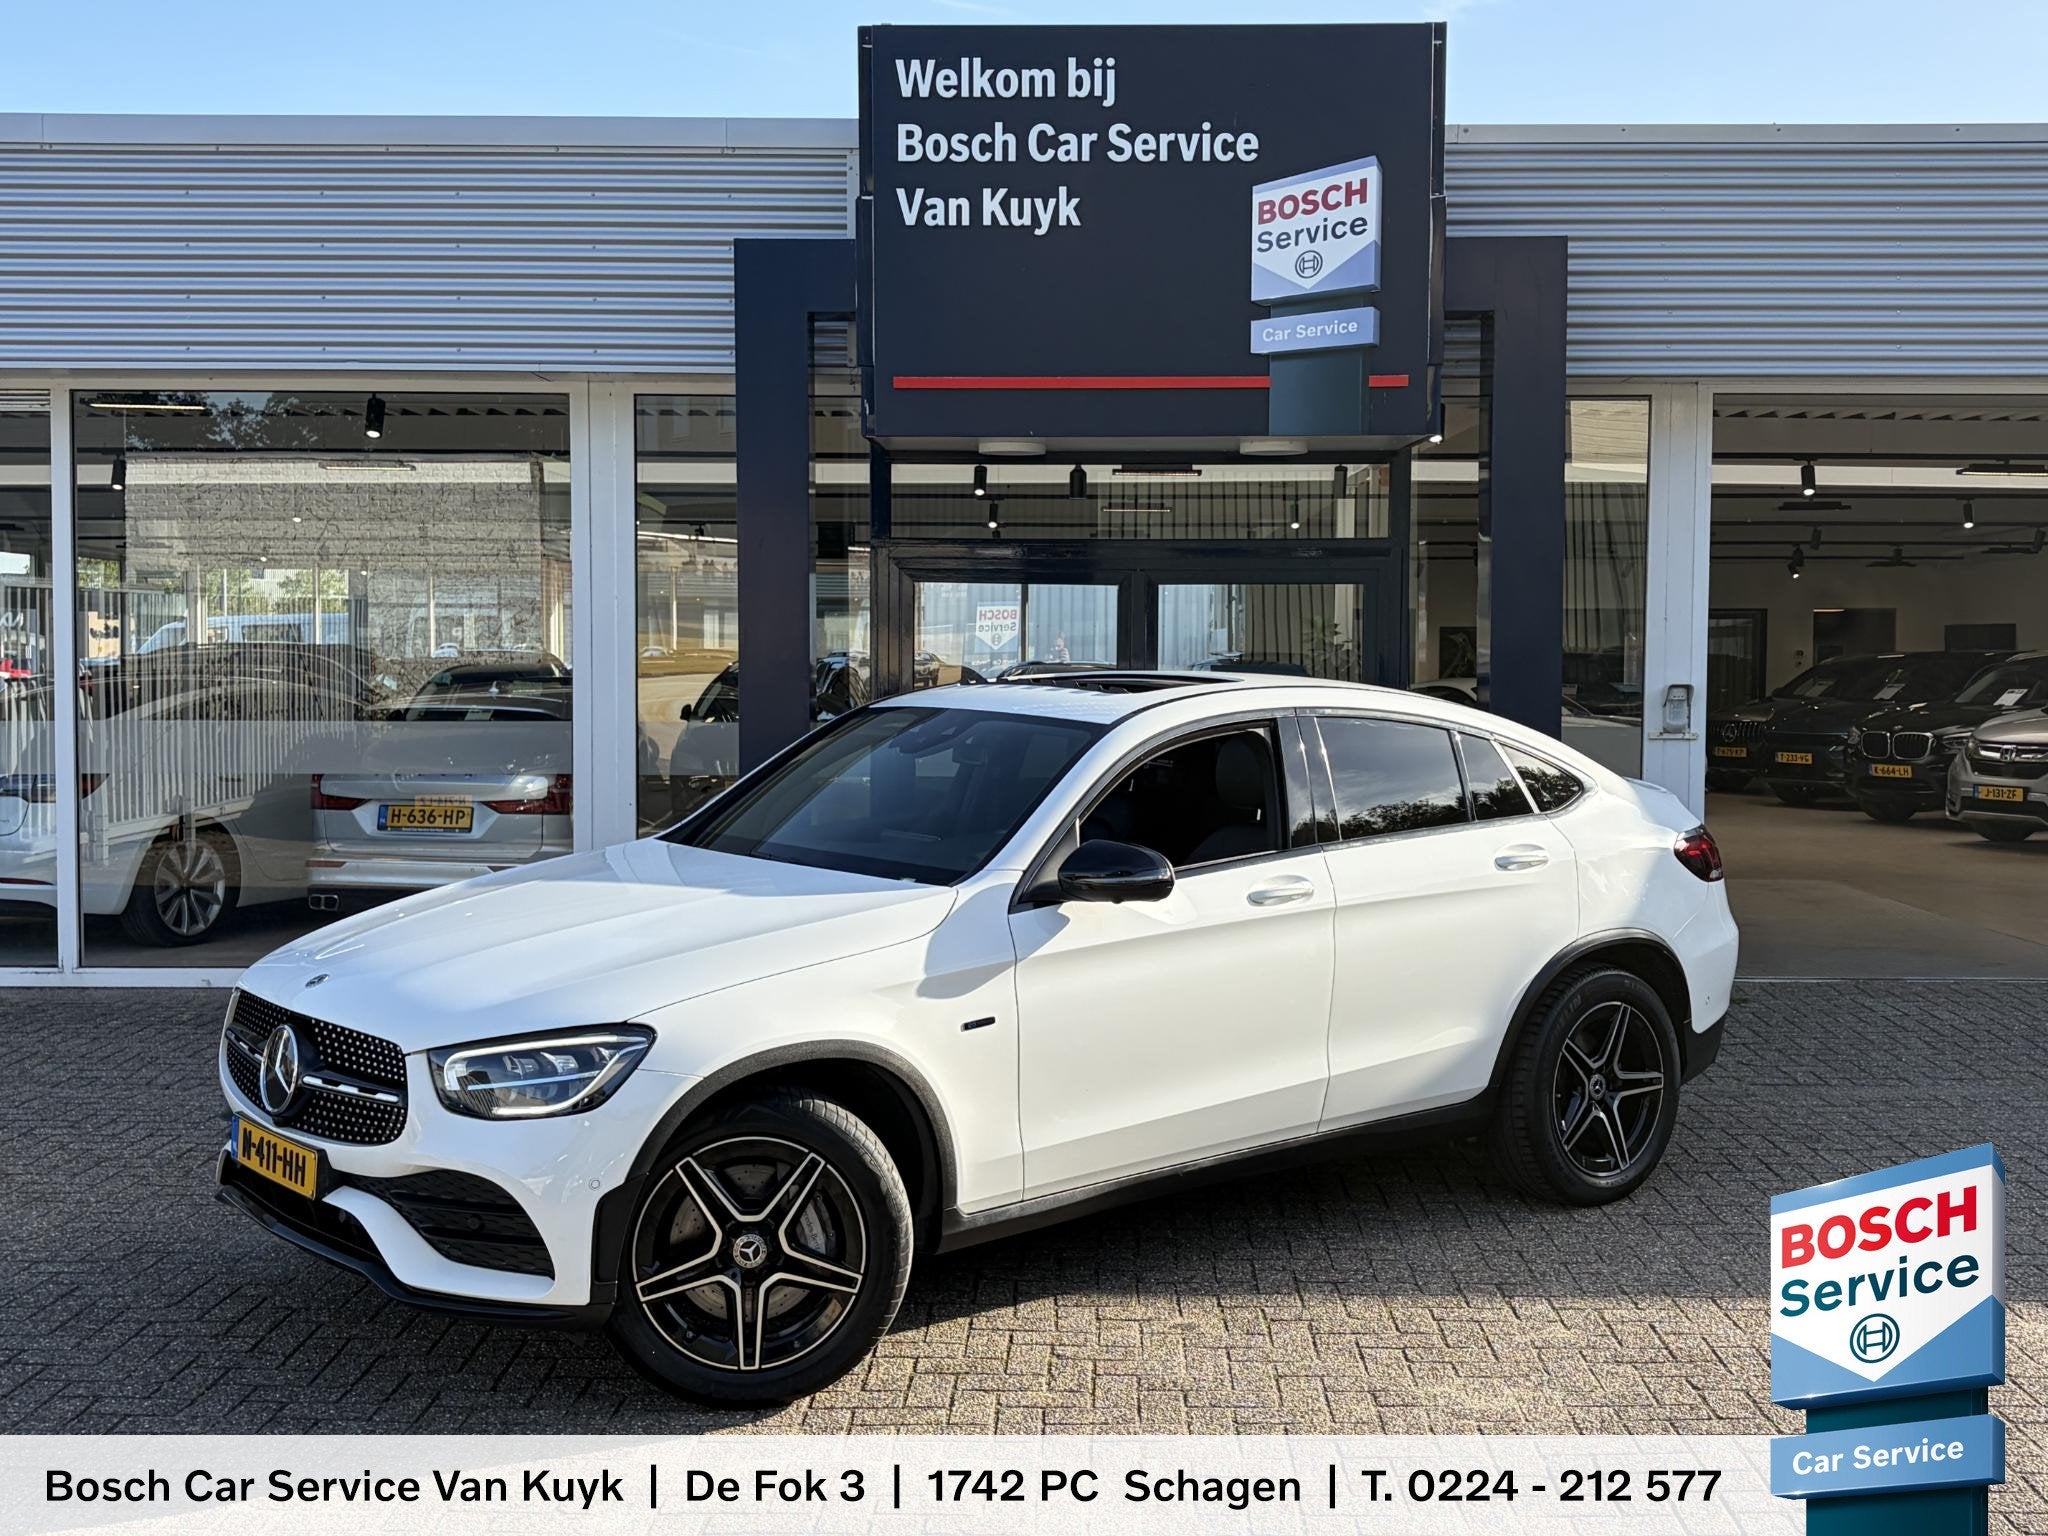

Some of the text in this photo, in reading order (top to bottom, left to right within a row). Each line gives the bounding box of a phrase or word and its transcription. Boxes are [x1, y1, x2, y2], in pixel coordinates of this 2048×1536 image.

[896, 57, 1116, 107] Welkom bij
[897, 122, 1259, 163] Bosch Car Service
[896, 187, 1081, 236] Van Kuyk
[1257, 178, 1368, 226] BOSCH
[1256, 214, 1368, 254] Service
[1262, 317, 1358, 342] Car Service
[1984, 787, 2017, 800] J-131-ZF
[390, 808, 466, 825] H-636-HP
[242, 1126, 306, 1188] N-411-HH
